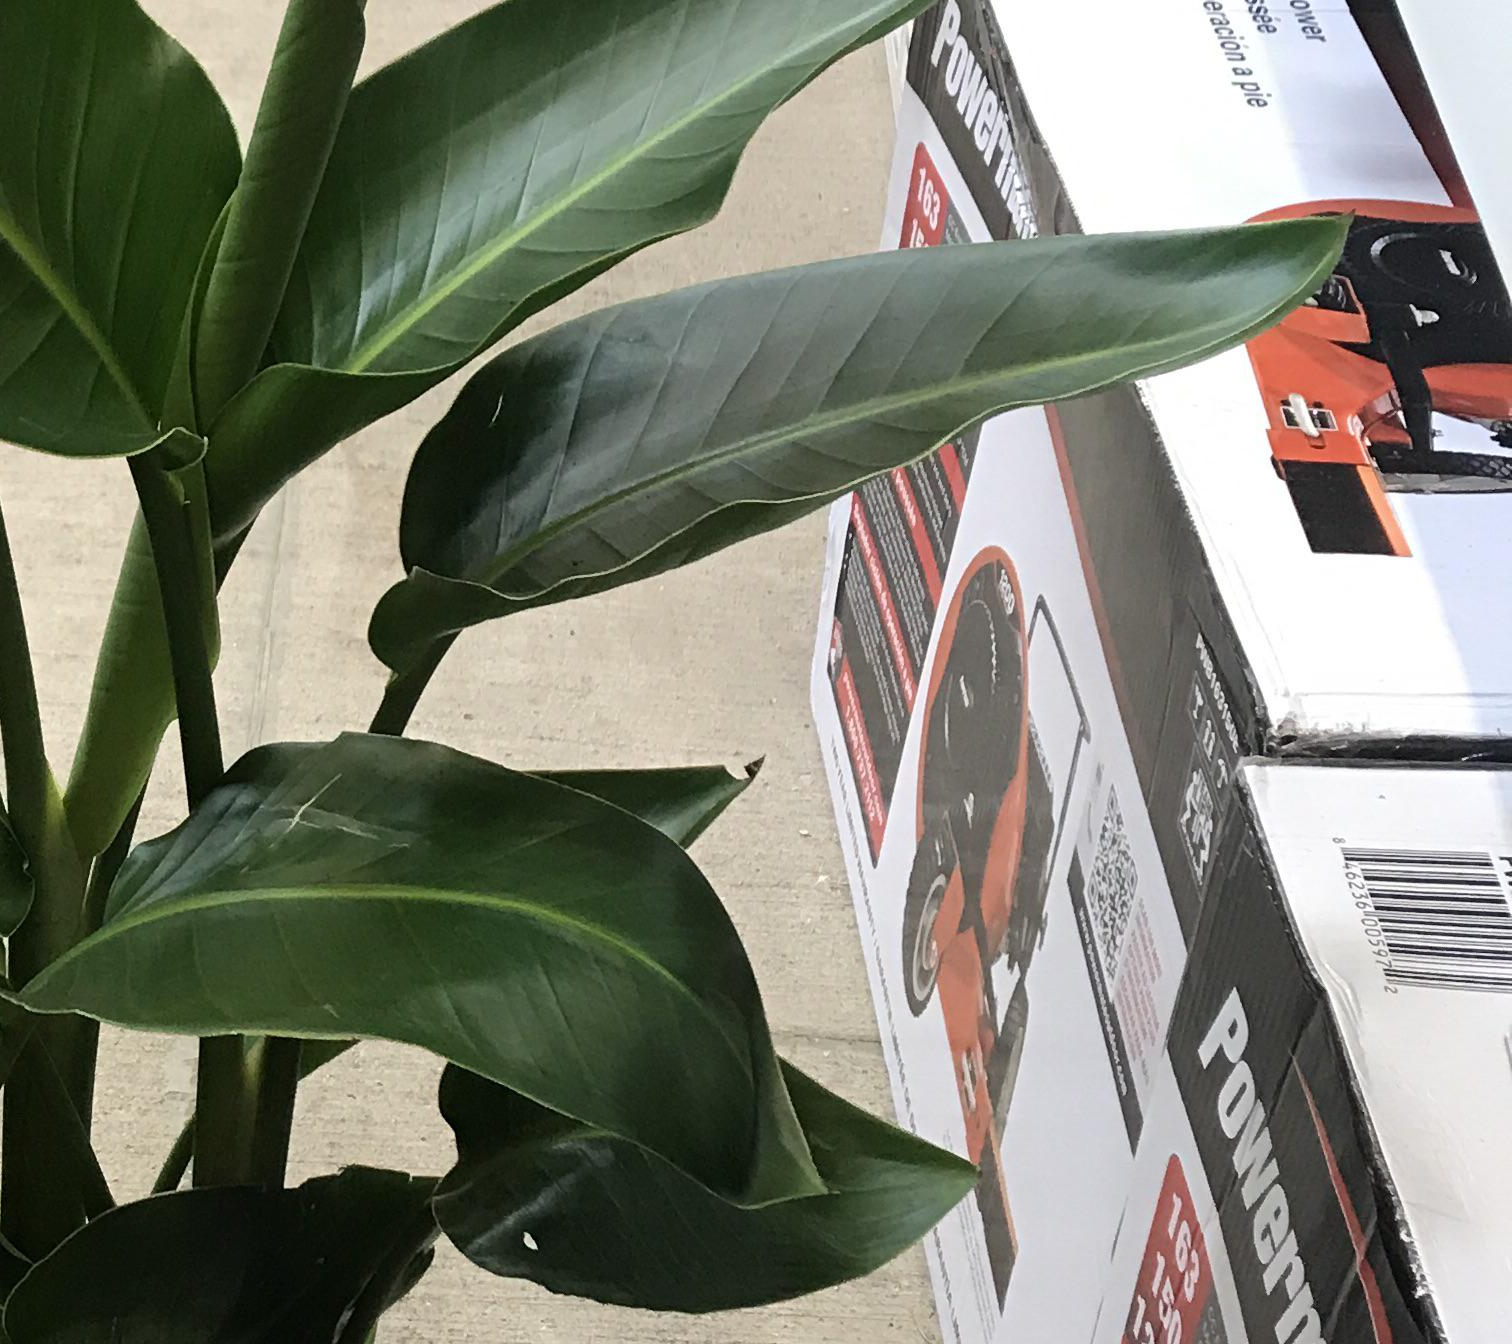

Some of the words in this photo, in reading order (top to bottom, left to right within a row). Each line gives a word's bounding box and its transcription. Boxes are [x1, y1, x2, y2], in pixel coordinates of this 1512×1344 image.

[1232, 66, 1253, 76] a
[1231, 81, 1272, 108] pie
[917, 168, 940, 231] 163
[909, 218, 929, 248] 15
[1343, 862, 1372, 909] 46236
[1361, 918, 1392, 968] 00597
[1384, 985, 1398, 994] 2
[1168, 1193, 1199, 1303] 163
